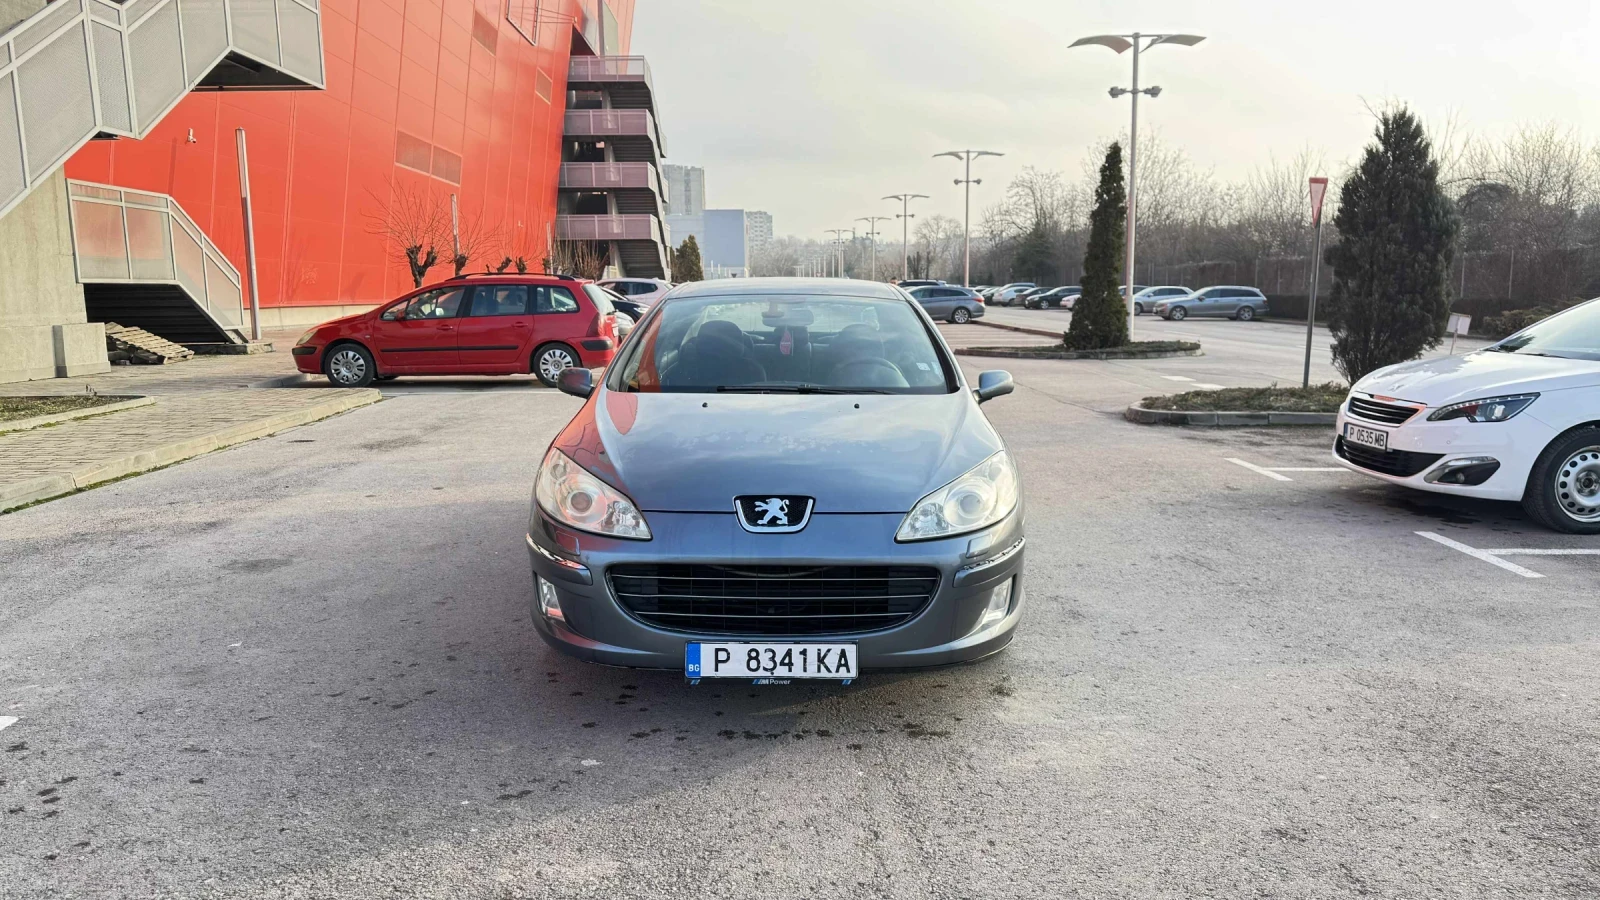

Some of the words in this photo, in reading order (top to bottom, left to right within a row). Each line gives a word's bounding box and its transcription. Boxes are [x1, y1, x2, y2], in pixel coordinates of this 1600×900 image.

[1350, 427, 1354, 439] P
[714, 648, 730, 672] P
[688, 664, 700, 672] BG
